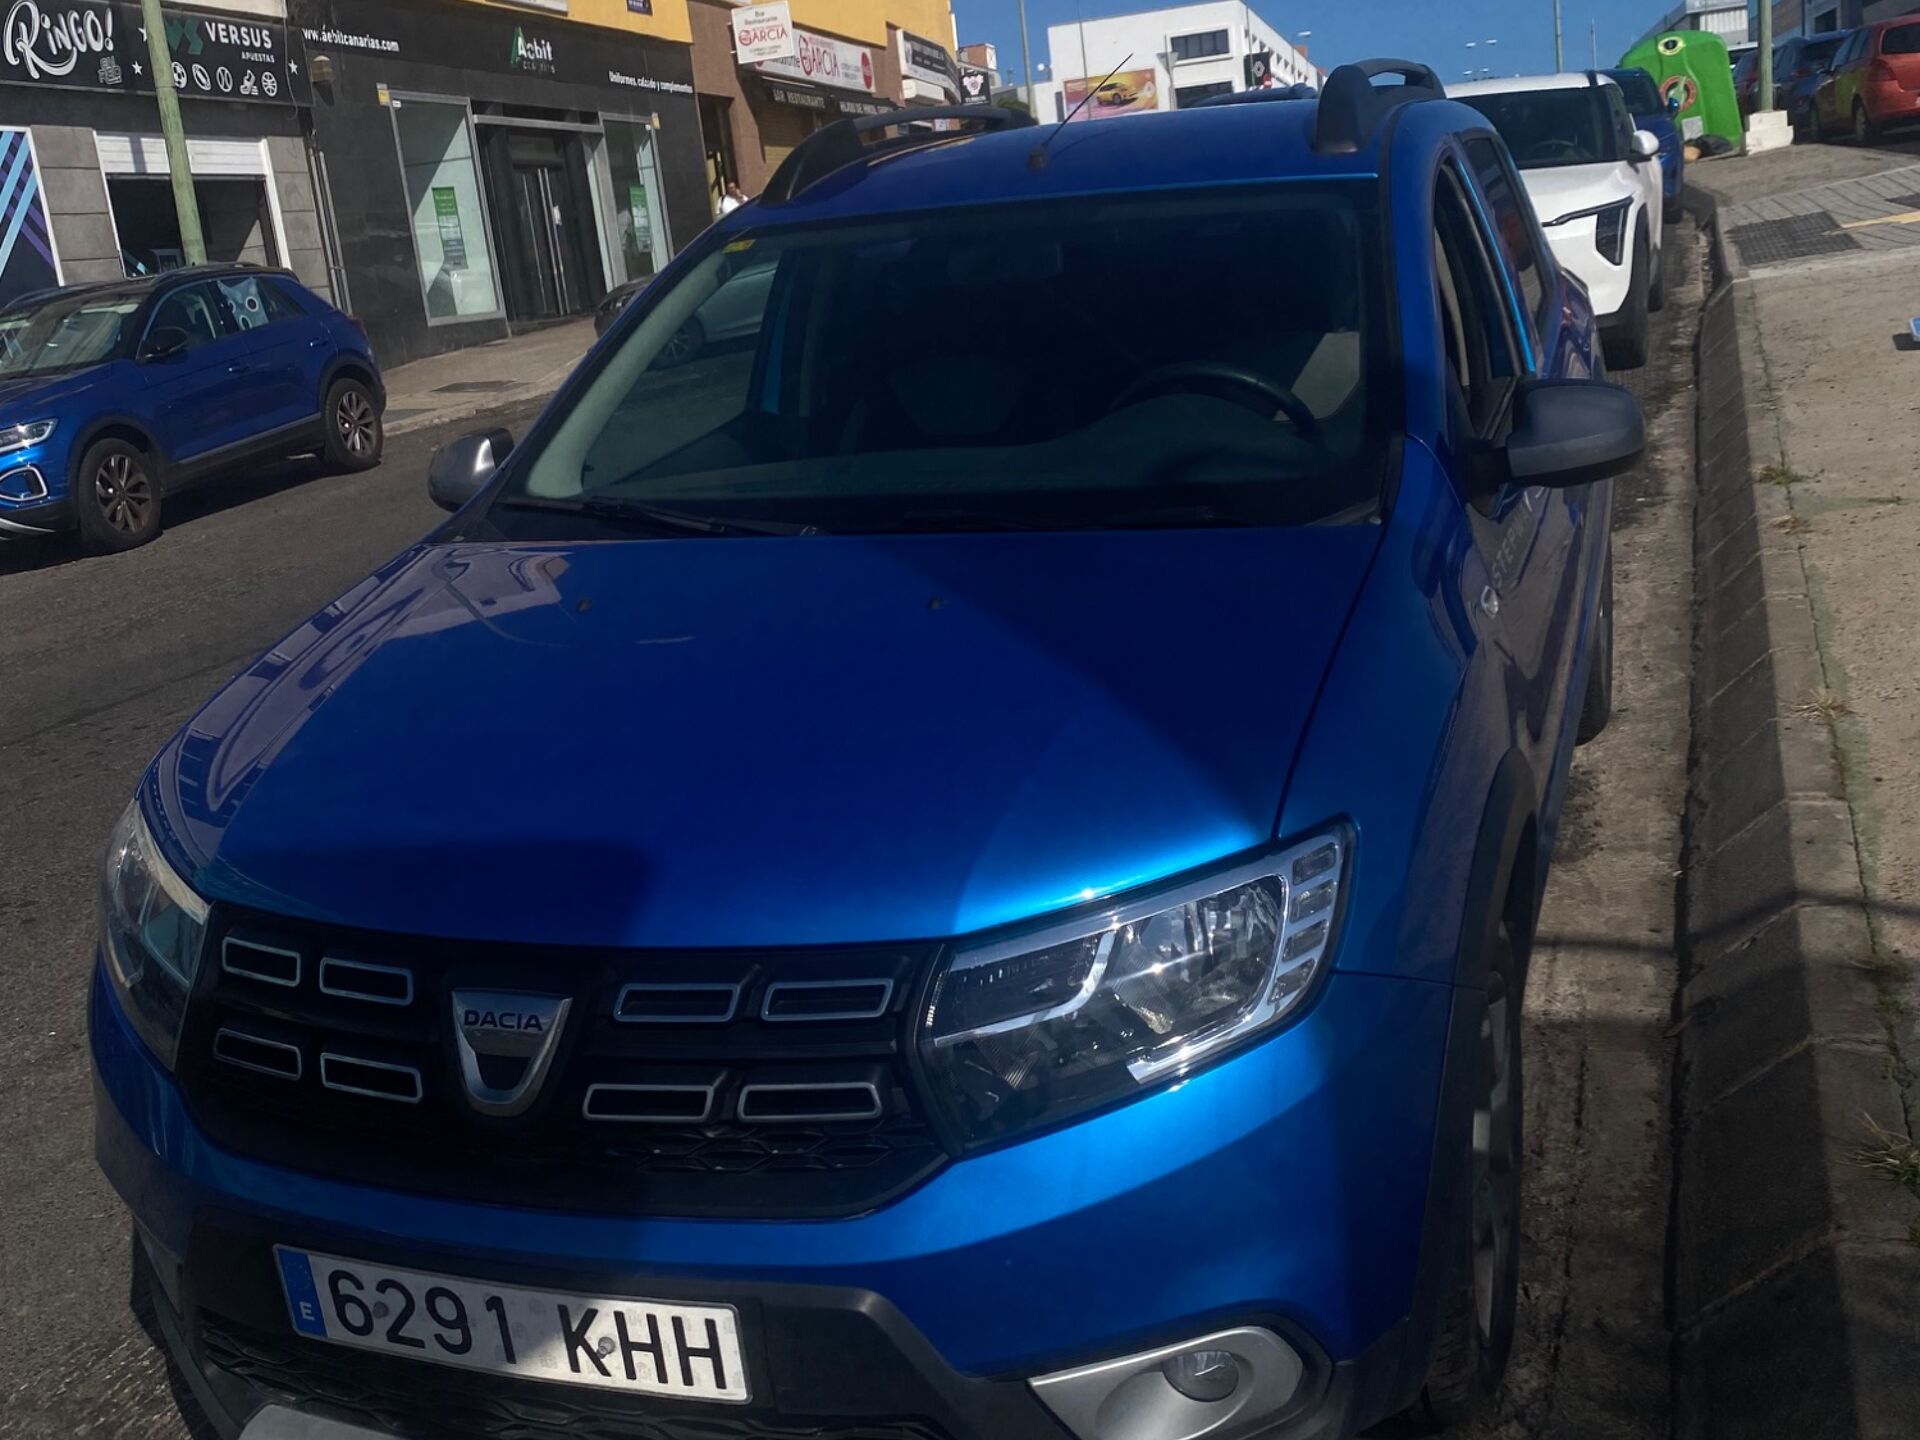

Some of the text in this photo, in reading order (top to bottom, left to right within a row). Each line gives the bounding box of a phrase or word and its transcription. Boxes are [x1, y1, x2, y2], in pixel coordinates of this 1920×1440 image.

[205, 21, 272, 49] VERSUS
[463, 1009, 543, 1032] DACIA
[301, 1268, 727, 1390] E 6291 KHH
